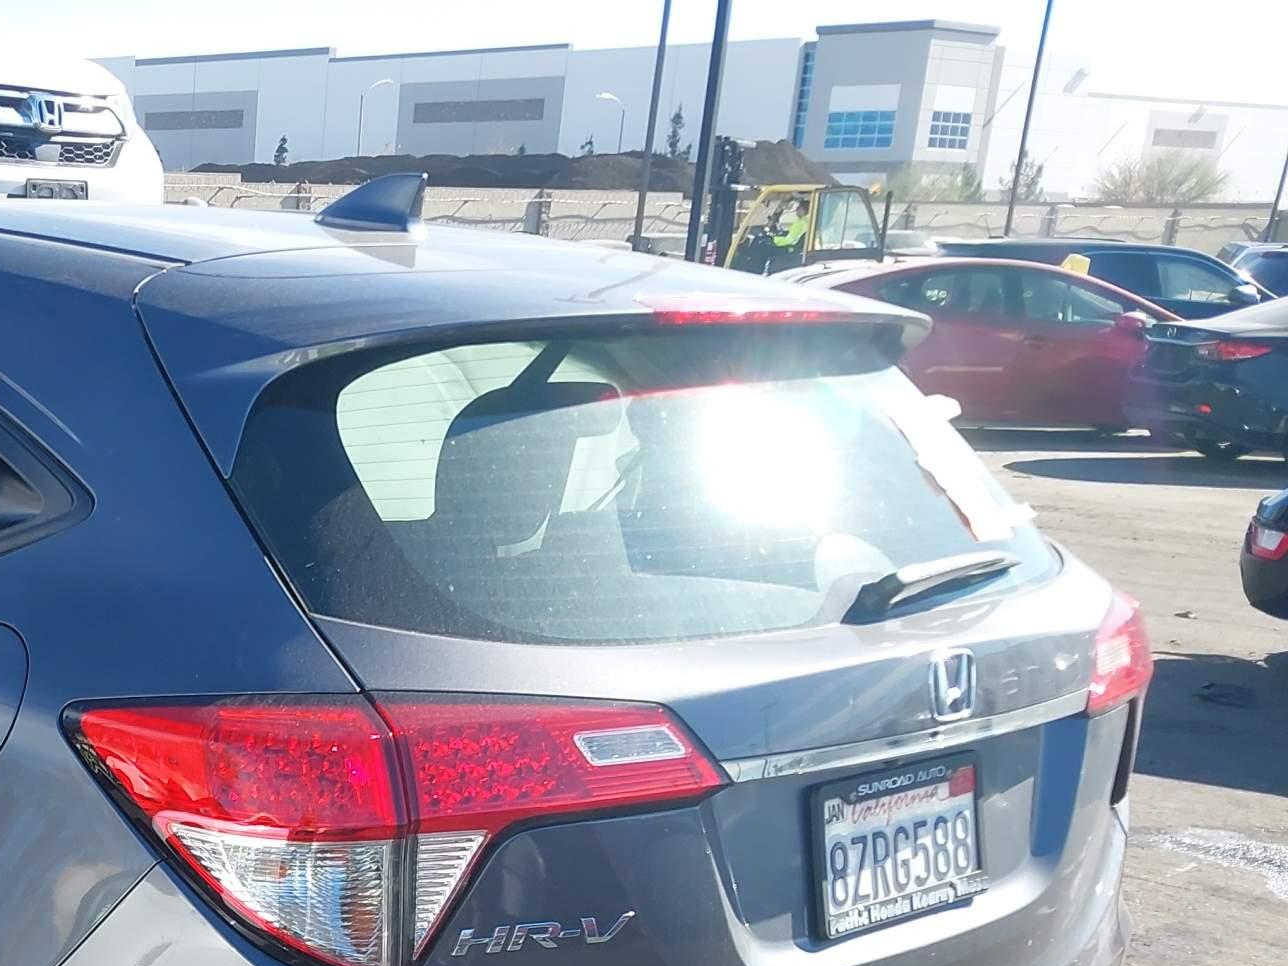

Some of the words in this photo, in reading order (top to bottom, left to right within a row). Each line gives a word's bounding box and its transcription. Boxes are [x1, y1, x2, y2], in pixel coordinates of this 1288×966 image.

[857, 773, 914, 797] SUNROAD
[916, 766, 946, 783] AUTO
[825, 802, 845, 824] JAN
[850, 785, 944, 826] California
[829, 810, 972, 908] 8ZRG588
[871, 898, 911, 923] Honda
[912, 887, 955, 910] Kearny
[451, 910, 636, 957] HR-V
